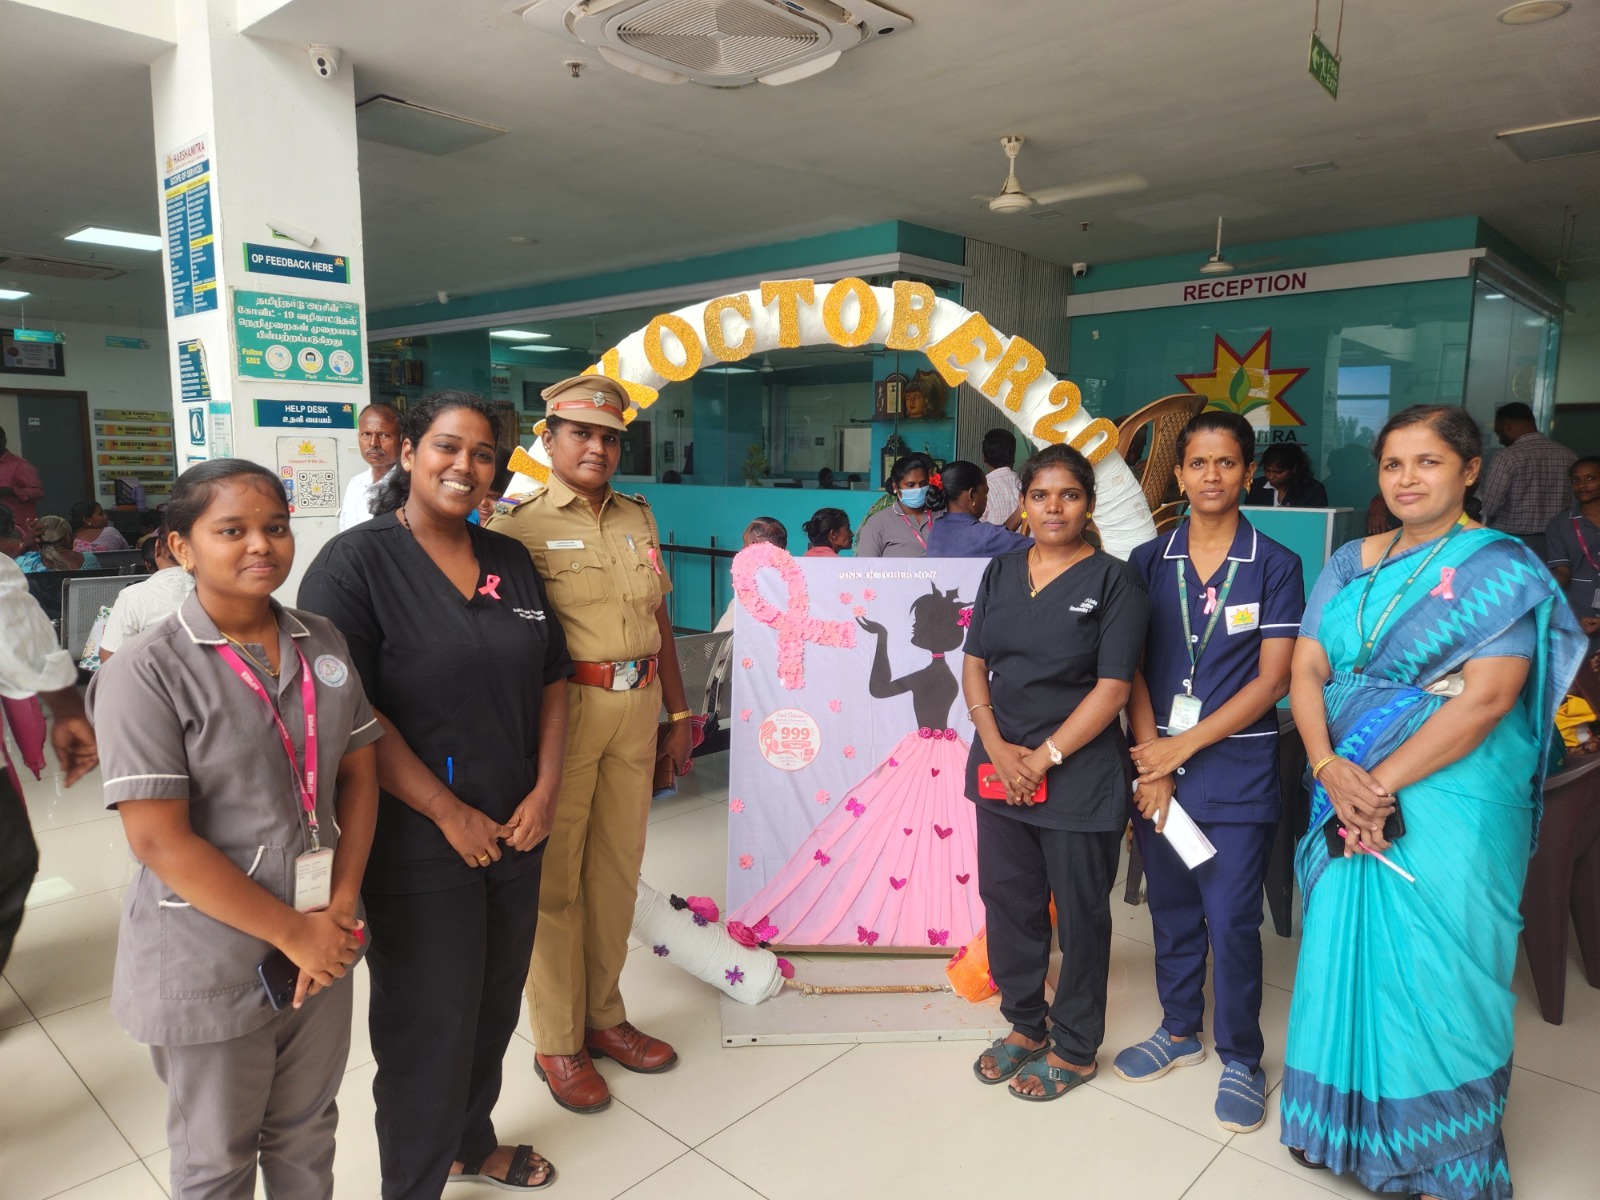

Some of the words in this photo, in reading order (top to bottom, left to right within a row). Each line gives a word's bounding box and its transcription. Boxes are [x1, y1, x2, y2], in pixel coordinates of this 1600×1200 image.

[251, 253, 264, 264] OP
[265, 255, 311, 270] FEEDBACK
[312, 261, 334, 273] HERE
[1183, 271, 1307, 302] RECEPTION
[237, 305, 276, 318] கோவிட்
[283, 310, 295, 319] 19
[256, 297, 305, 310] தமிழ்நாடு
[306, 302, 340, 313] அரசின்
[310, 325, 358, 336] முறையாக
[242, 347, 263, 357] Follow
[643, 277, 1047, 413] OCTOBER
[245, 356, 261, 365] SMS
[284, 404, 306, 413] HELP
[307, 405, 329, 414] DESK
[282, 414, 305, 424] உதவி
[305, 415, 333, 424] மையம்
[838, 570, 862, 580] PINK
[864, 570, 912, 580] OCTOBER
[1386, 594, 1402, 613] HOSPITAL
[781, 726, 811, 741] 999
